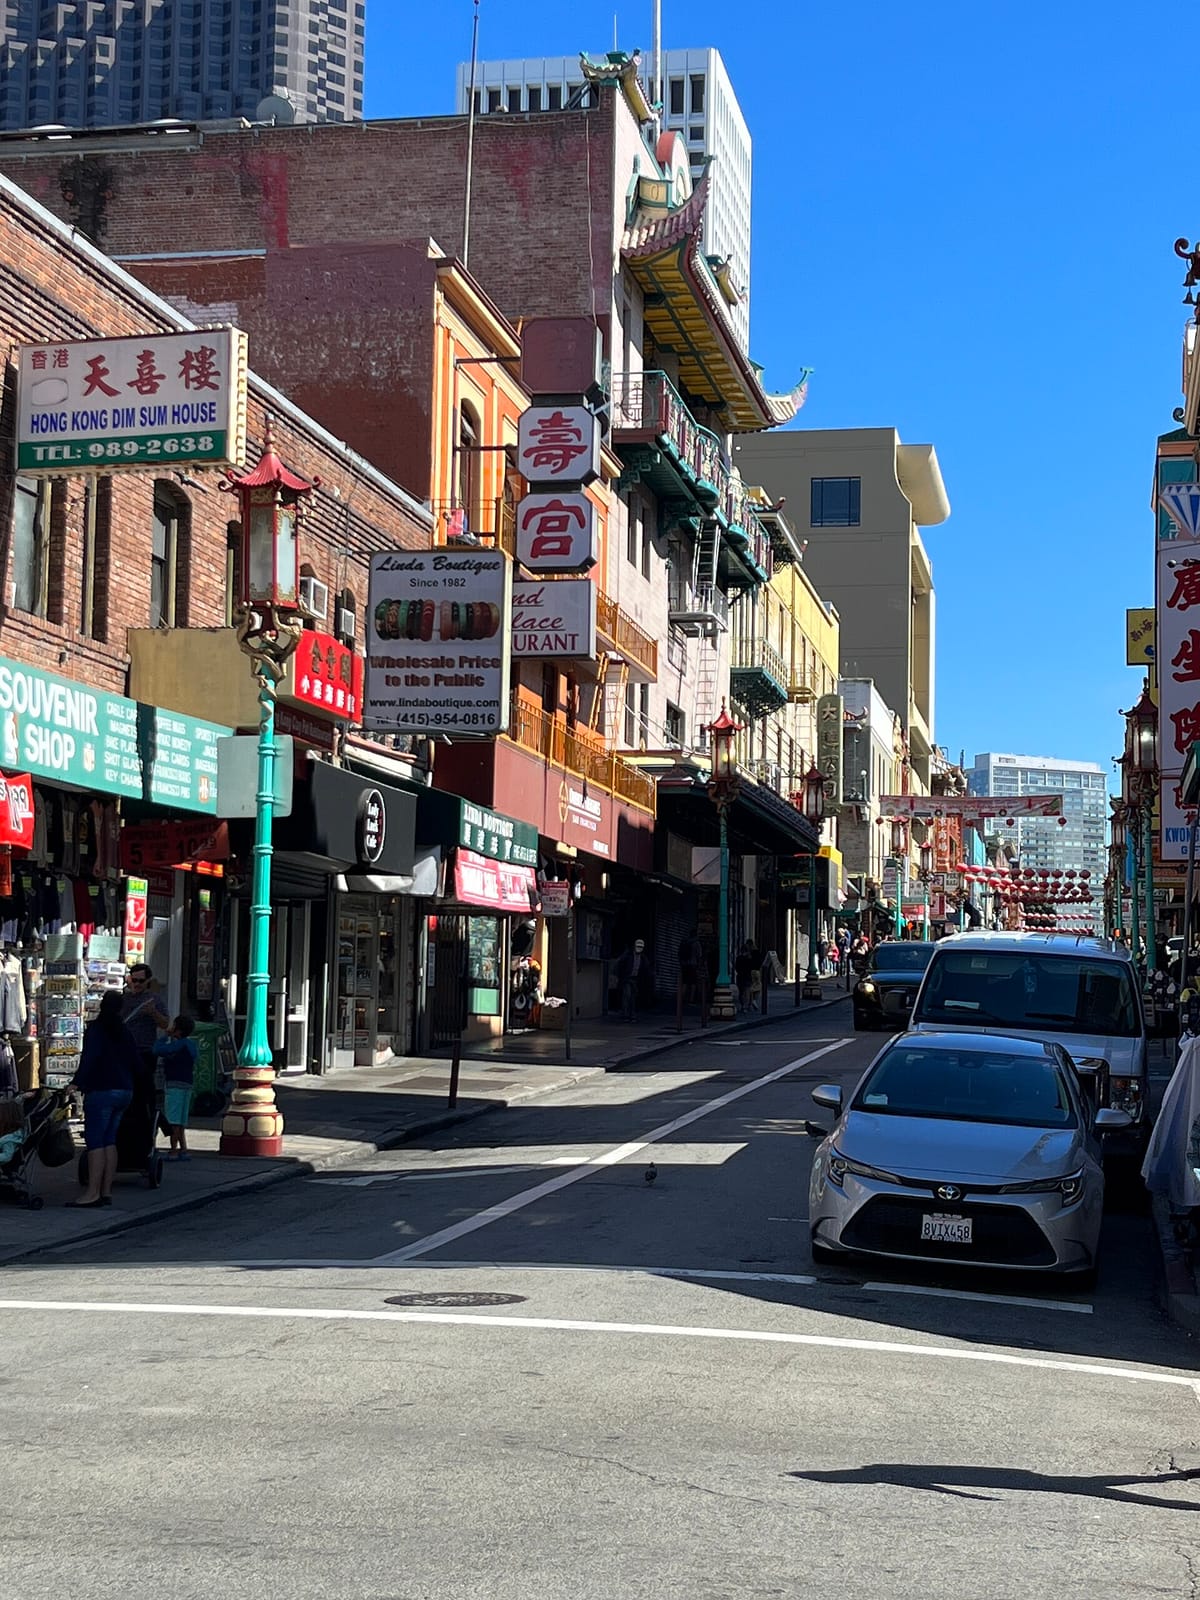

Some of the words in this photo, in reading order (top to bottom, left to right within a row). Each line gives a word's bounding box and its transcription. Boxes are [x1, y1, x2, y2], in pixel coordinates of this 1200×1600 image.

[31, 349, 69, 370] 香港
[83, 346, 221, 398] 天喜樓
[31, 412, 68, 434] HONG
[72, 409, 108, 432] KONG
[112, 407, 135, 429] DIM
[139, 405, 168, 427] SUM
[171, 402, 216, 425] HOUSE
[32, 446, 82, 462] TEL:
[89, 435, 214, 458] 989-2638
[376, 556, 425, 572] Linda
[432, 555, 501, 575] Boutique
[409, 578, 439, 588] Since
[442, 578, 466, 588] 1982
[369, 655, 456, 669] Wholesale
[459, 655, 501, 669] Price
[385, 674, 401, 687] to
[404, 673, 431, 687] the
[434, 673, 485, 687] Public
[0, 666, 99, 736] SOUVENIR
[369, 698, 500, 710] www.lindaboutique.com
[396, 713, 496, 727] (415)-954-0816
[24, 723, 76, 771] SHOP
